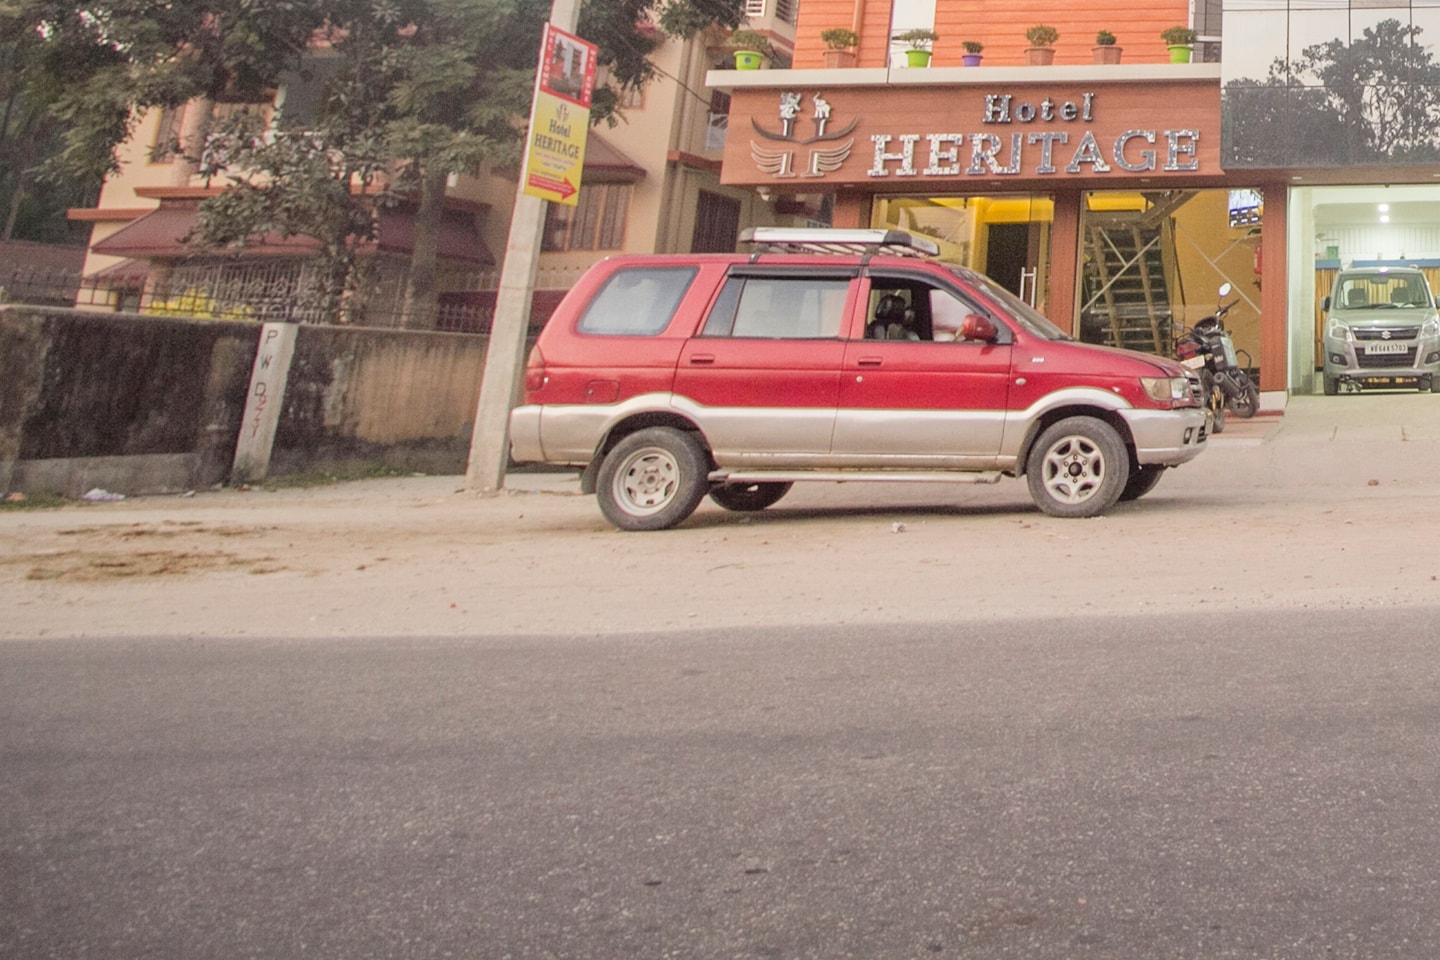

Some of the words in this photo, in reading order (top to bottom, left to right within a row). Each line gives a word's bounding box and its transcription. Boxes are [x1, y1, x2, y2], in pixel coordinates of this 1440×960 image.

[982, 92, 1095, 124] Hotel
[549, 119, 572, 138] Hotel
[534, 132, 580, 159] HERITAGE
[866, 128, 1200, 177] HERITAGE
